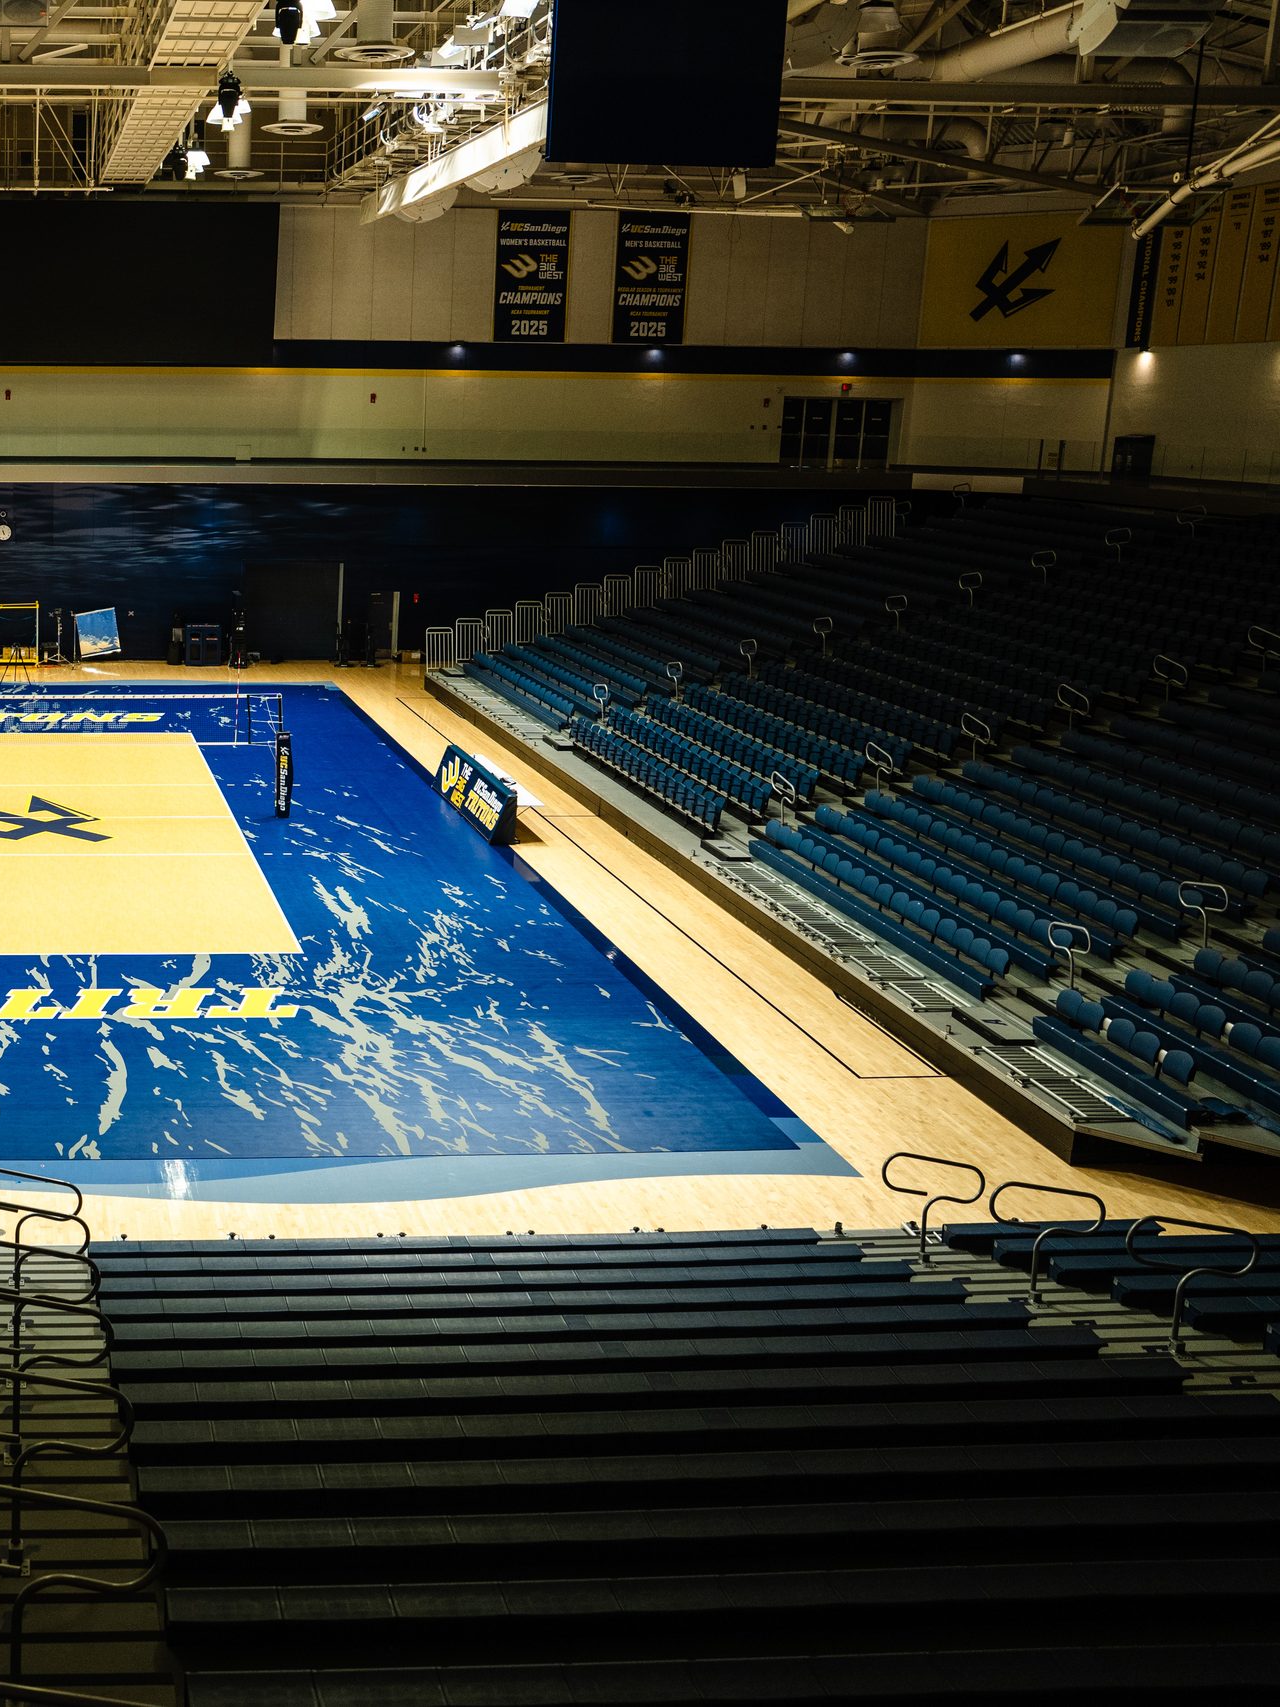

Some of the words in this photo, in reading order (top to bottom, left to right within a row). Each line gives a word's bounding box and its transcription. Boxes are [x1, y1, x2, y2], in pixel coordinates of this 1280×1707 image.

[500, 238, 528, 246] WOMEN'S
[529, 238, 567, 247] BASKETBALL
[644, 240, 682, 248] BASKETBALL
[540, 254, 558, 262] THE
[659, 256, 678, 264] THE
[1141, 230, 1155, 279] ATIONAL
[538, 271, 564, 280] WEST
[658, 273, 682, 282] WEST
[499, 292, 562, 305] CHAMPIONS
[618, 294, 682, 307] CHAMPIONS
[1133, 280, 1148, 342] CHAMPIONS
[511, 320, 548, 335] 2025
[630, 322, 666, 337] 2025
[461, 762, 474, 781] THE
[464, 789, 500, 831] TRITONS
